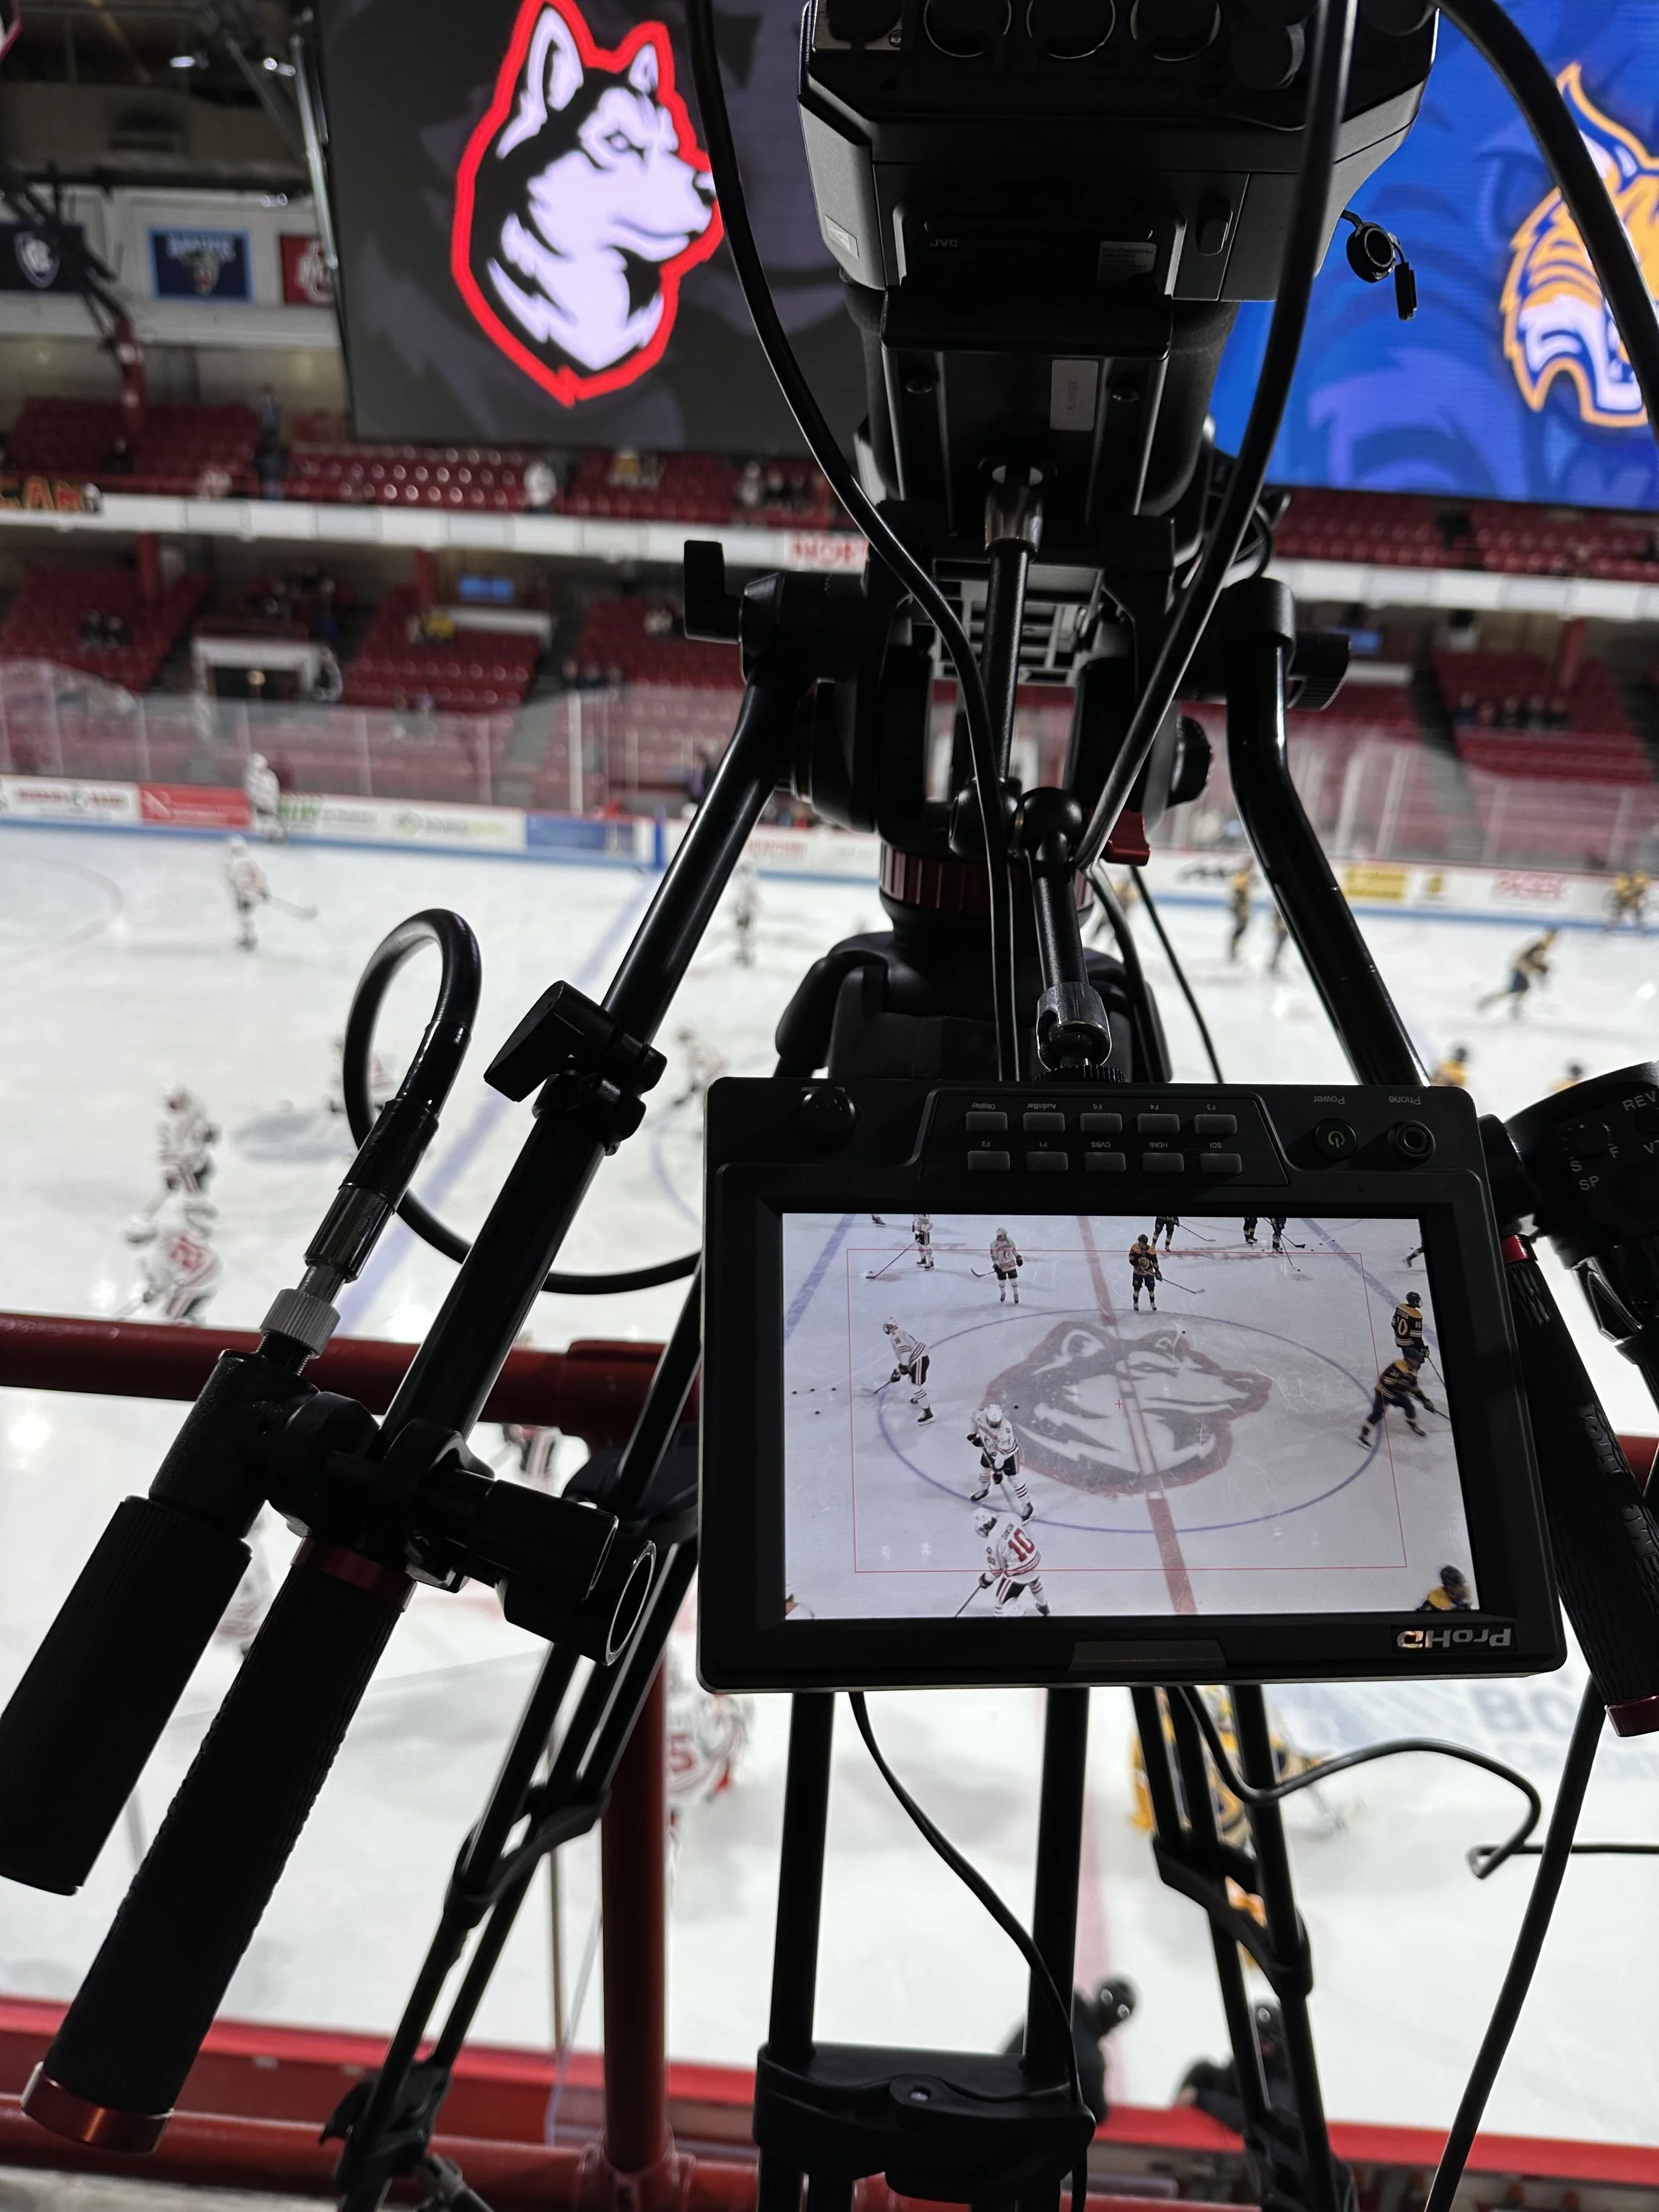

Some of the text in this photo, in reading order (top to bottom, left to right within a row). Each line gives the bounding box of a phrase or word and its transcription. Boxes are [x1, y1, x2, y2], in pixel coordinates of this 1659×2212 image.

[929, 238, 959, 248] JVC
[1313, 1095, 1346, 1104] Power
[1388, 1095, 1421, 1105] Phone
[1569, 1160, 1582, 1172] S
[1578, 1175, 1601, 1191] SP
[1007, 1527, 1035, 1562] 10
[1396, 1628, 1512, 1649] ProHD
